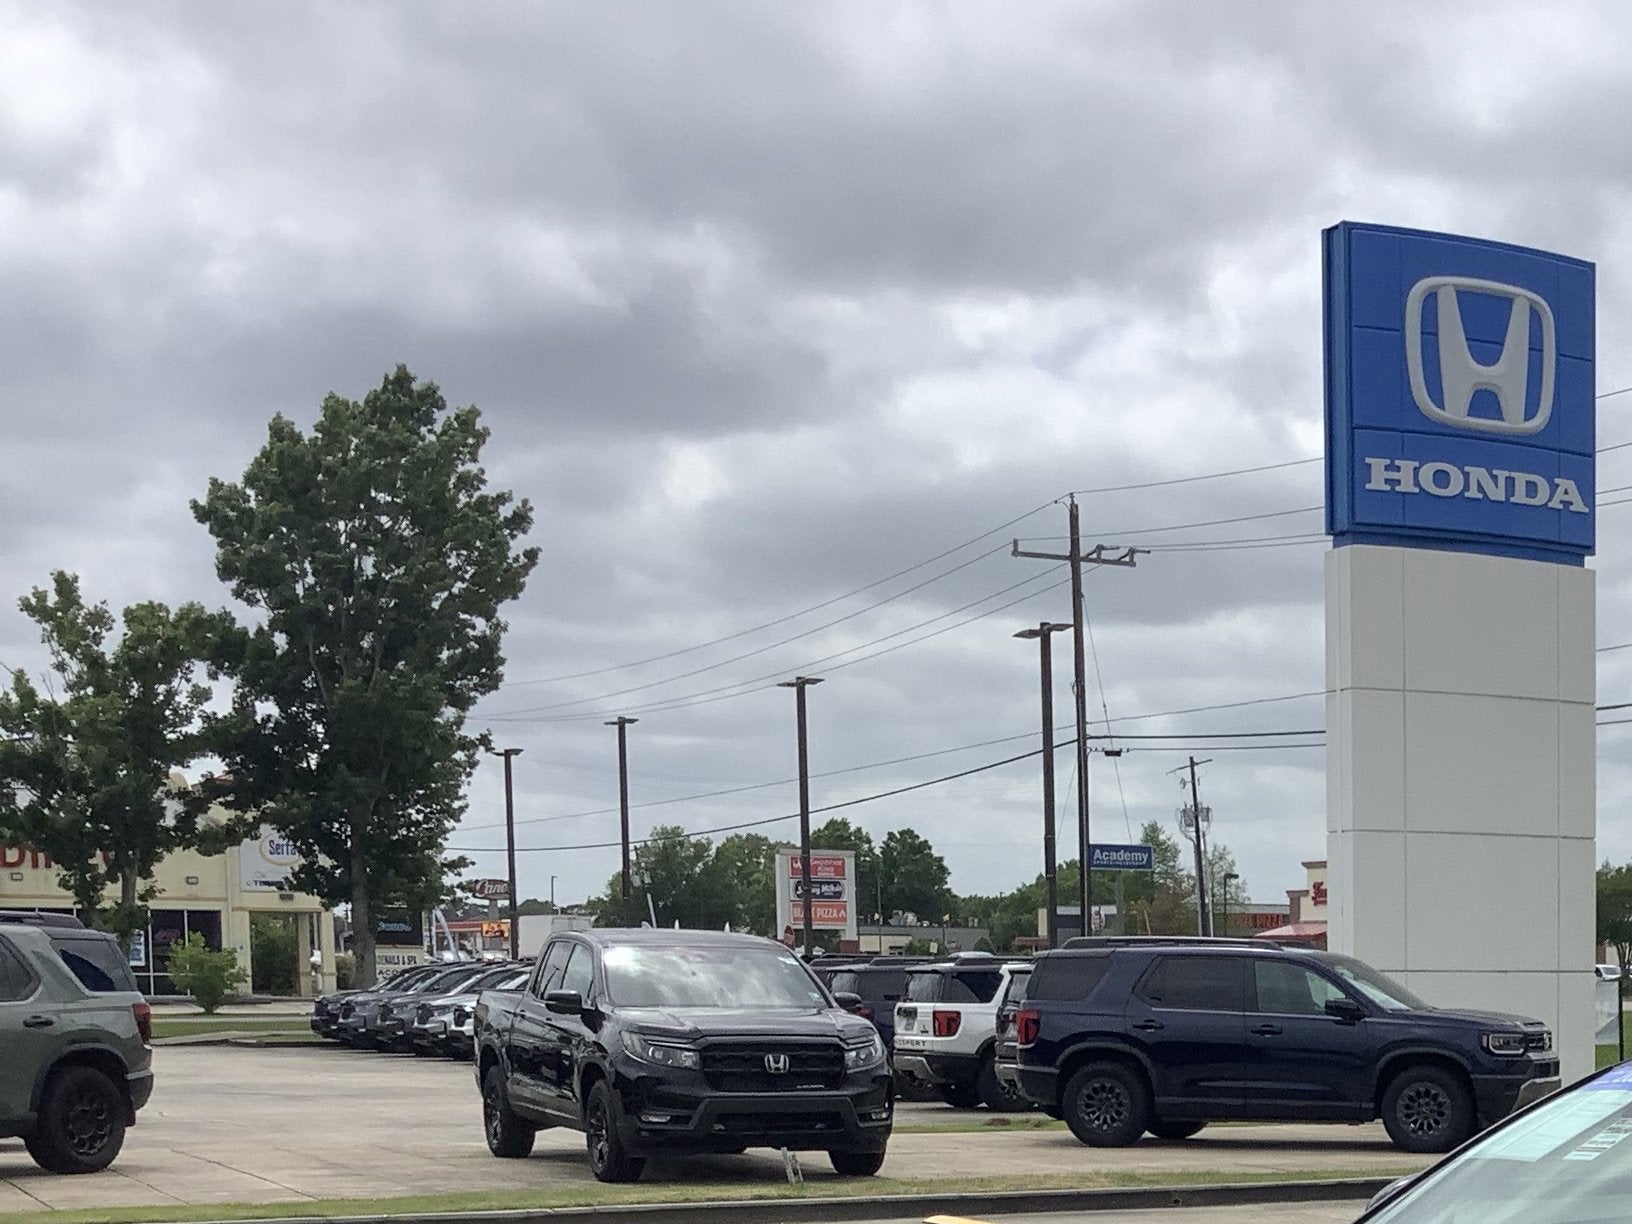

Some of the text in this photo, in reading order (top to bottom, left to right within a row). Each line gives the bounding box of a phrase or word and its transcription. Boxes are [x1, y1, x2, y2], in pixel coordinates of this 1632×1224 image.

[1364, 456, 1590, 513] HONDA
[1093, 849, 1149, 865] Academy
[816, 907, 839, 919] PIZZA
